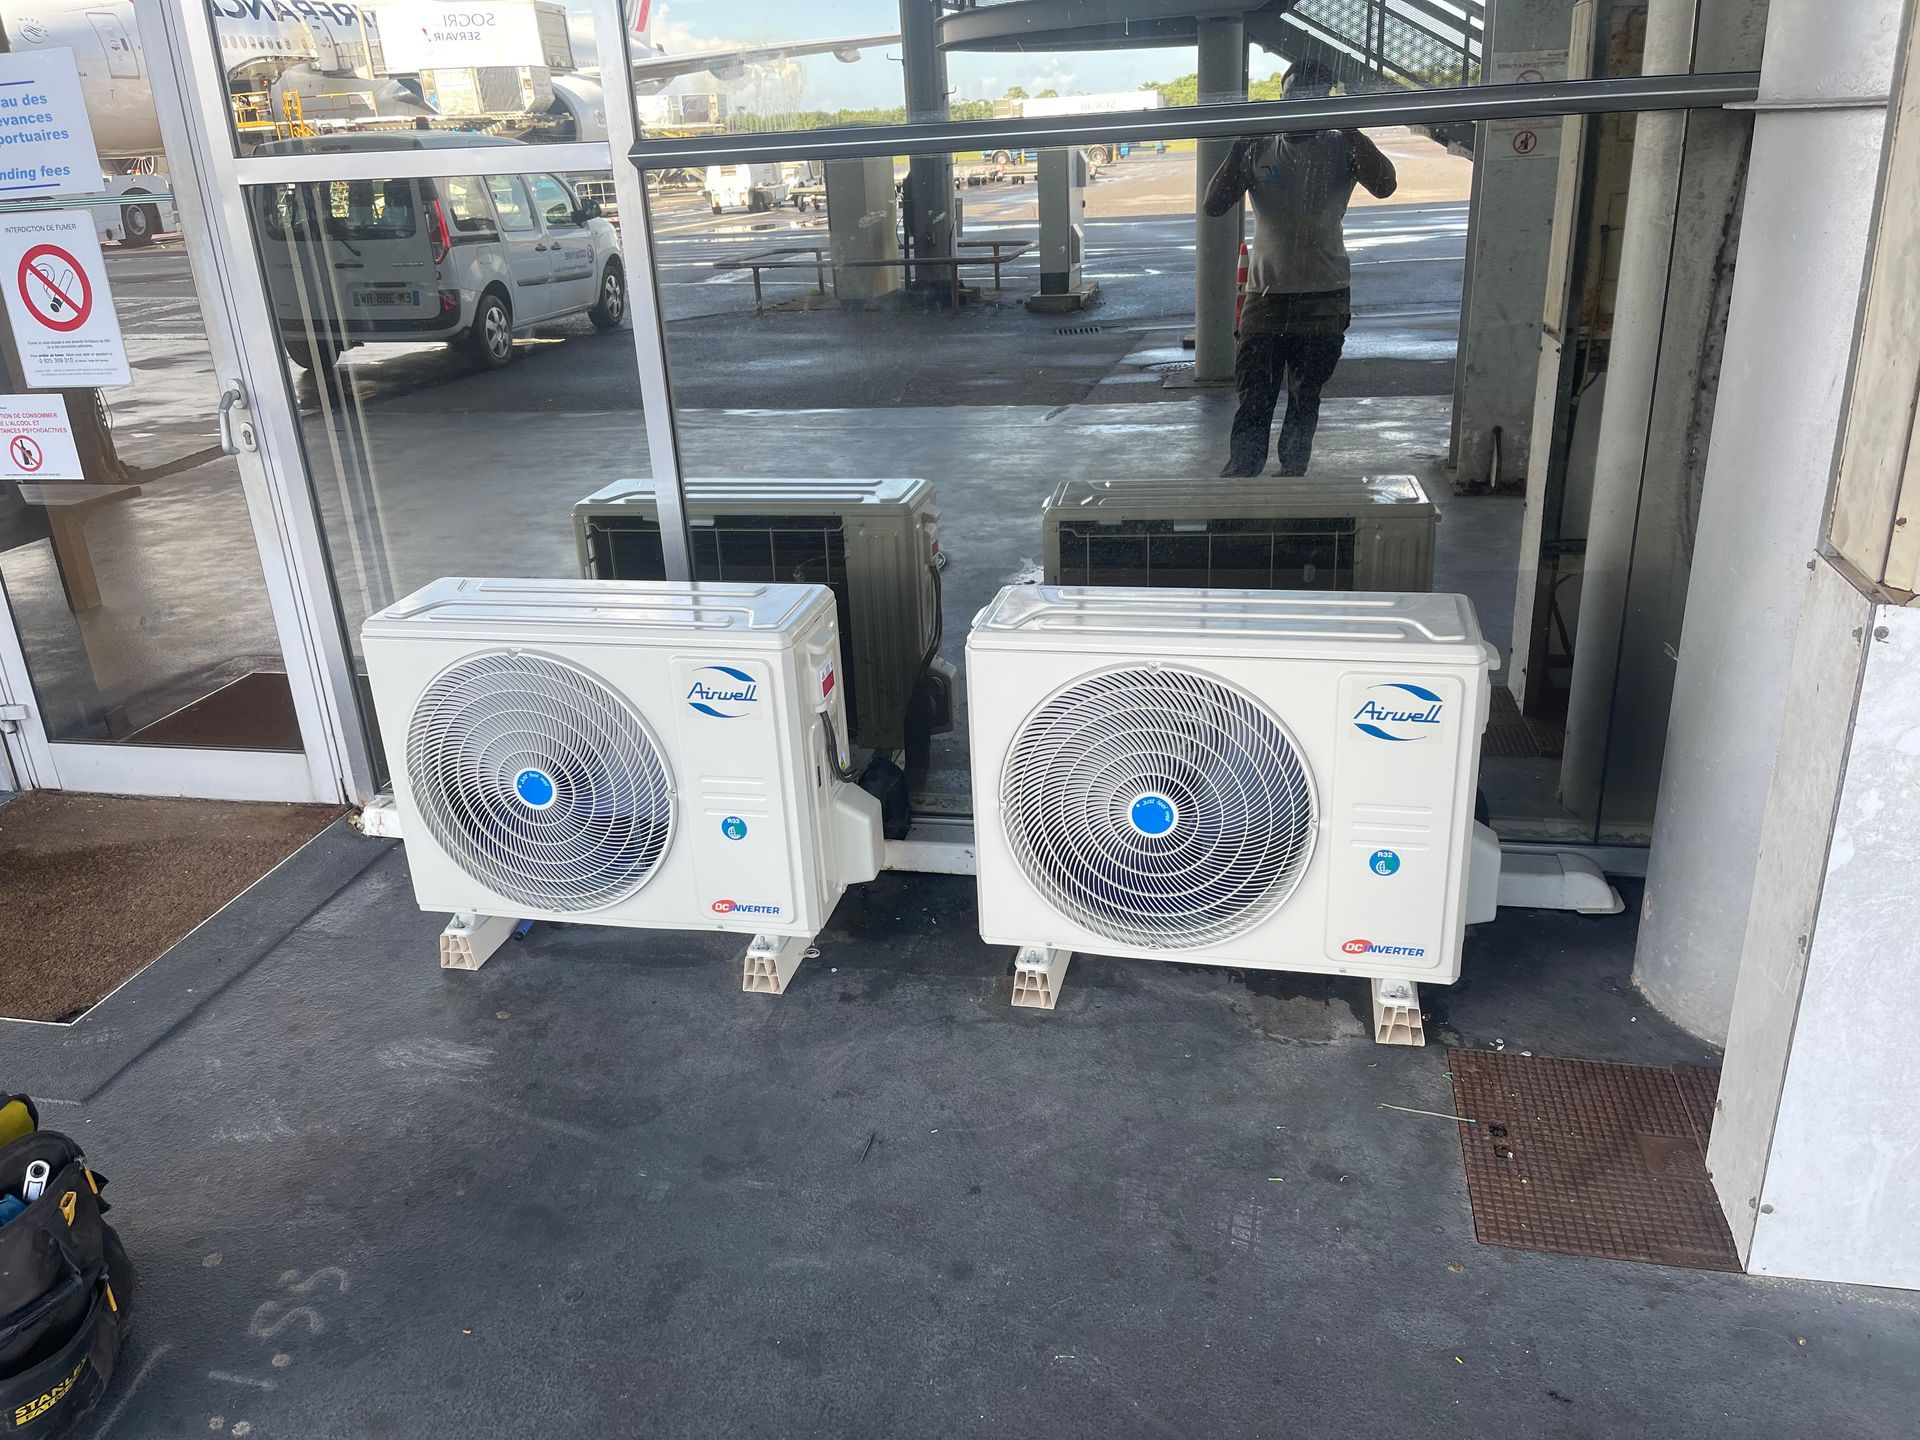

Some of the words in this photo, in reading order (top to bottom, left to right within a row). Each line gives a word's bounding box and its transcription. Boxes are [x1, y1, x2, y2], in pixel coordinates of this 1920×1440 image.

[0, 97, 18, 108] au
[22, 94, 48, 106] des
[41, 165, 71, 177] fees
[5, 225, 46, 234] INTERDICTION
[47, 224, 55, 232] DE
[55, 223, 77, 231] FUMER
[686, 682, 758, 702] Airwell
[1353, 700, 1443, 724] Airwell
